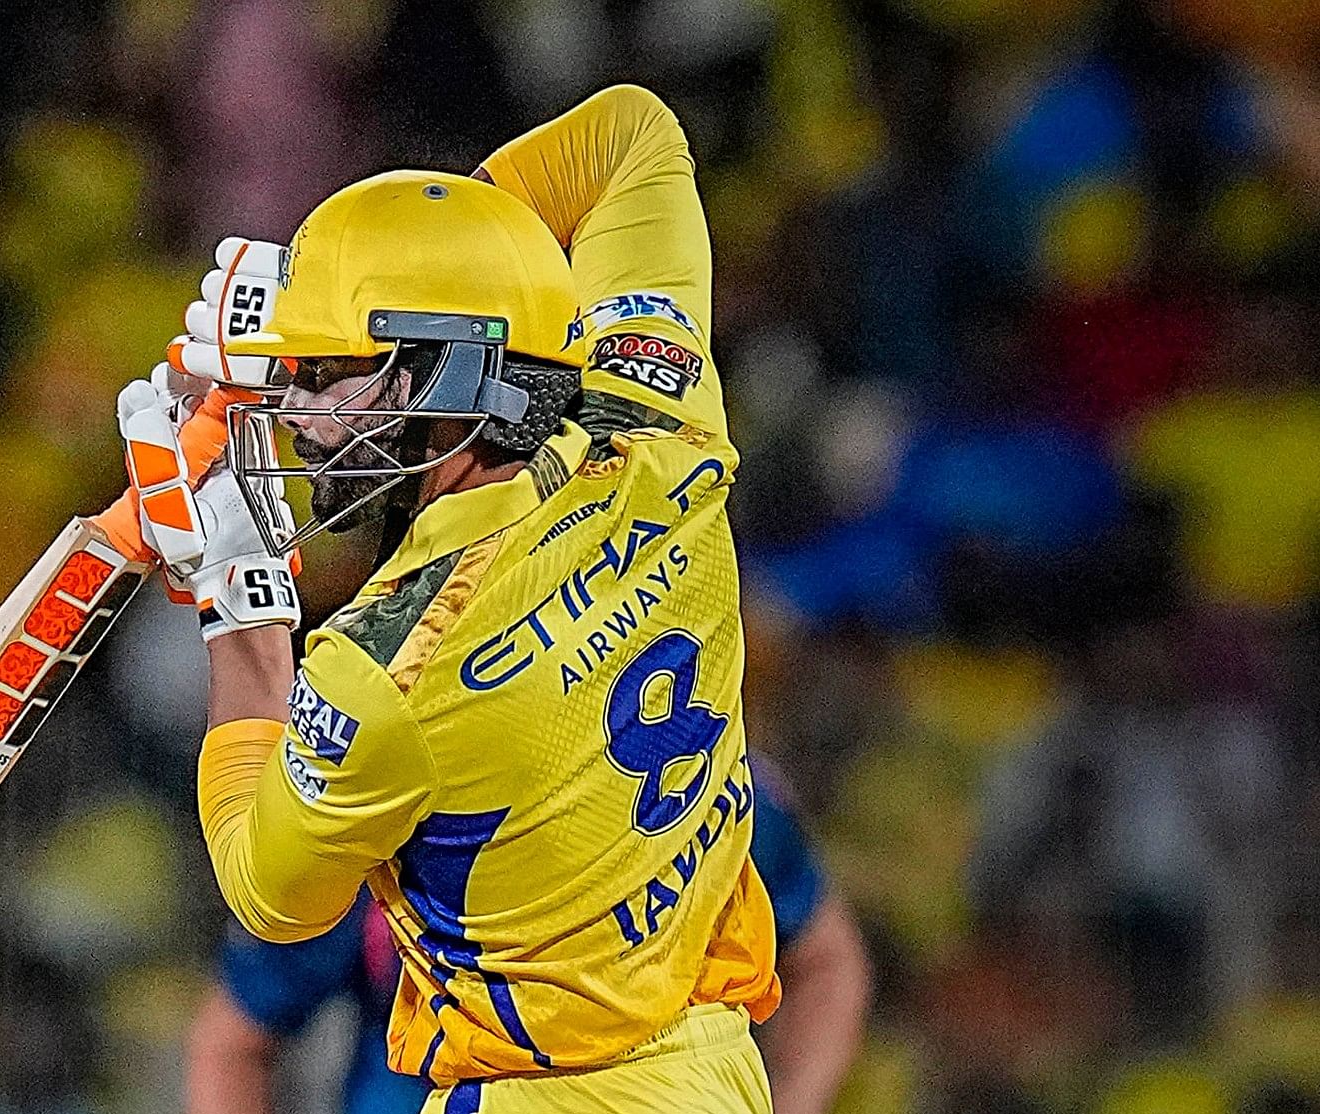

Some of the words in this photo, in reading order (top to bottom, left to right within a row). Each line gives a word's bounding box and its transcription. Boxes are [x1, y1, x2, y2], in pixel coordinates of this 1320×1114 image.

[228, 284, 266, 336] SS
[244, 568, 296, 609] SS
[560, 543, 690, 697] AIRWAYS
[603, 628, 730, 837] 8
